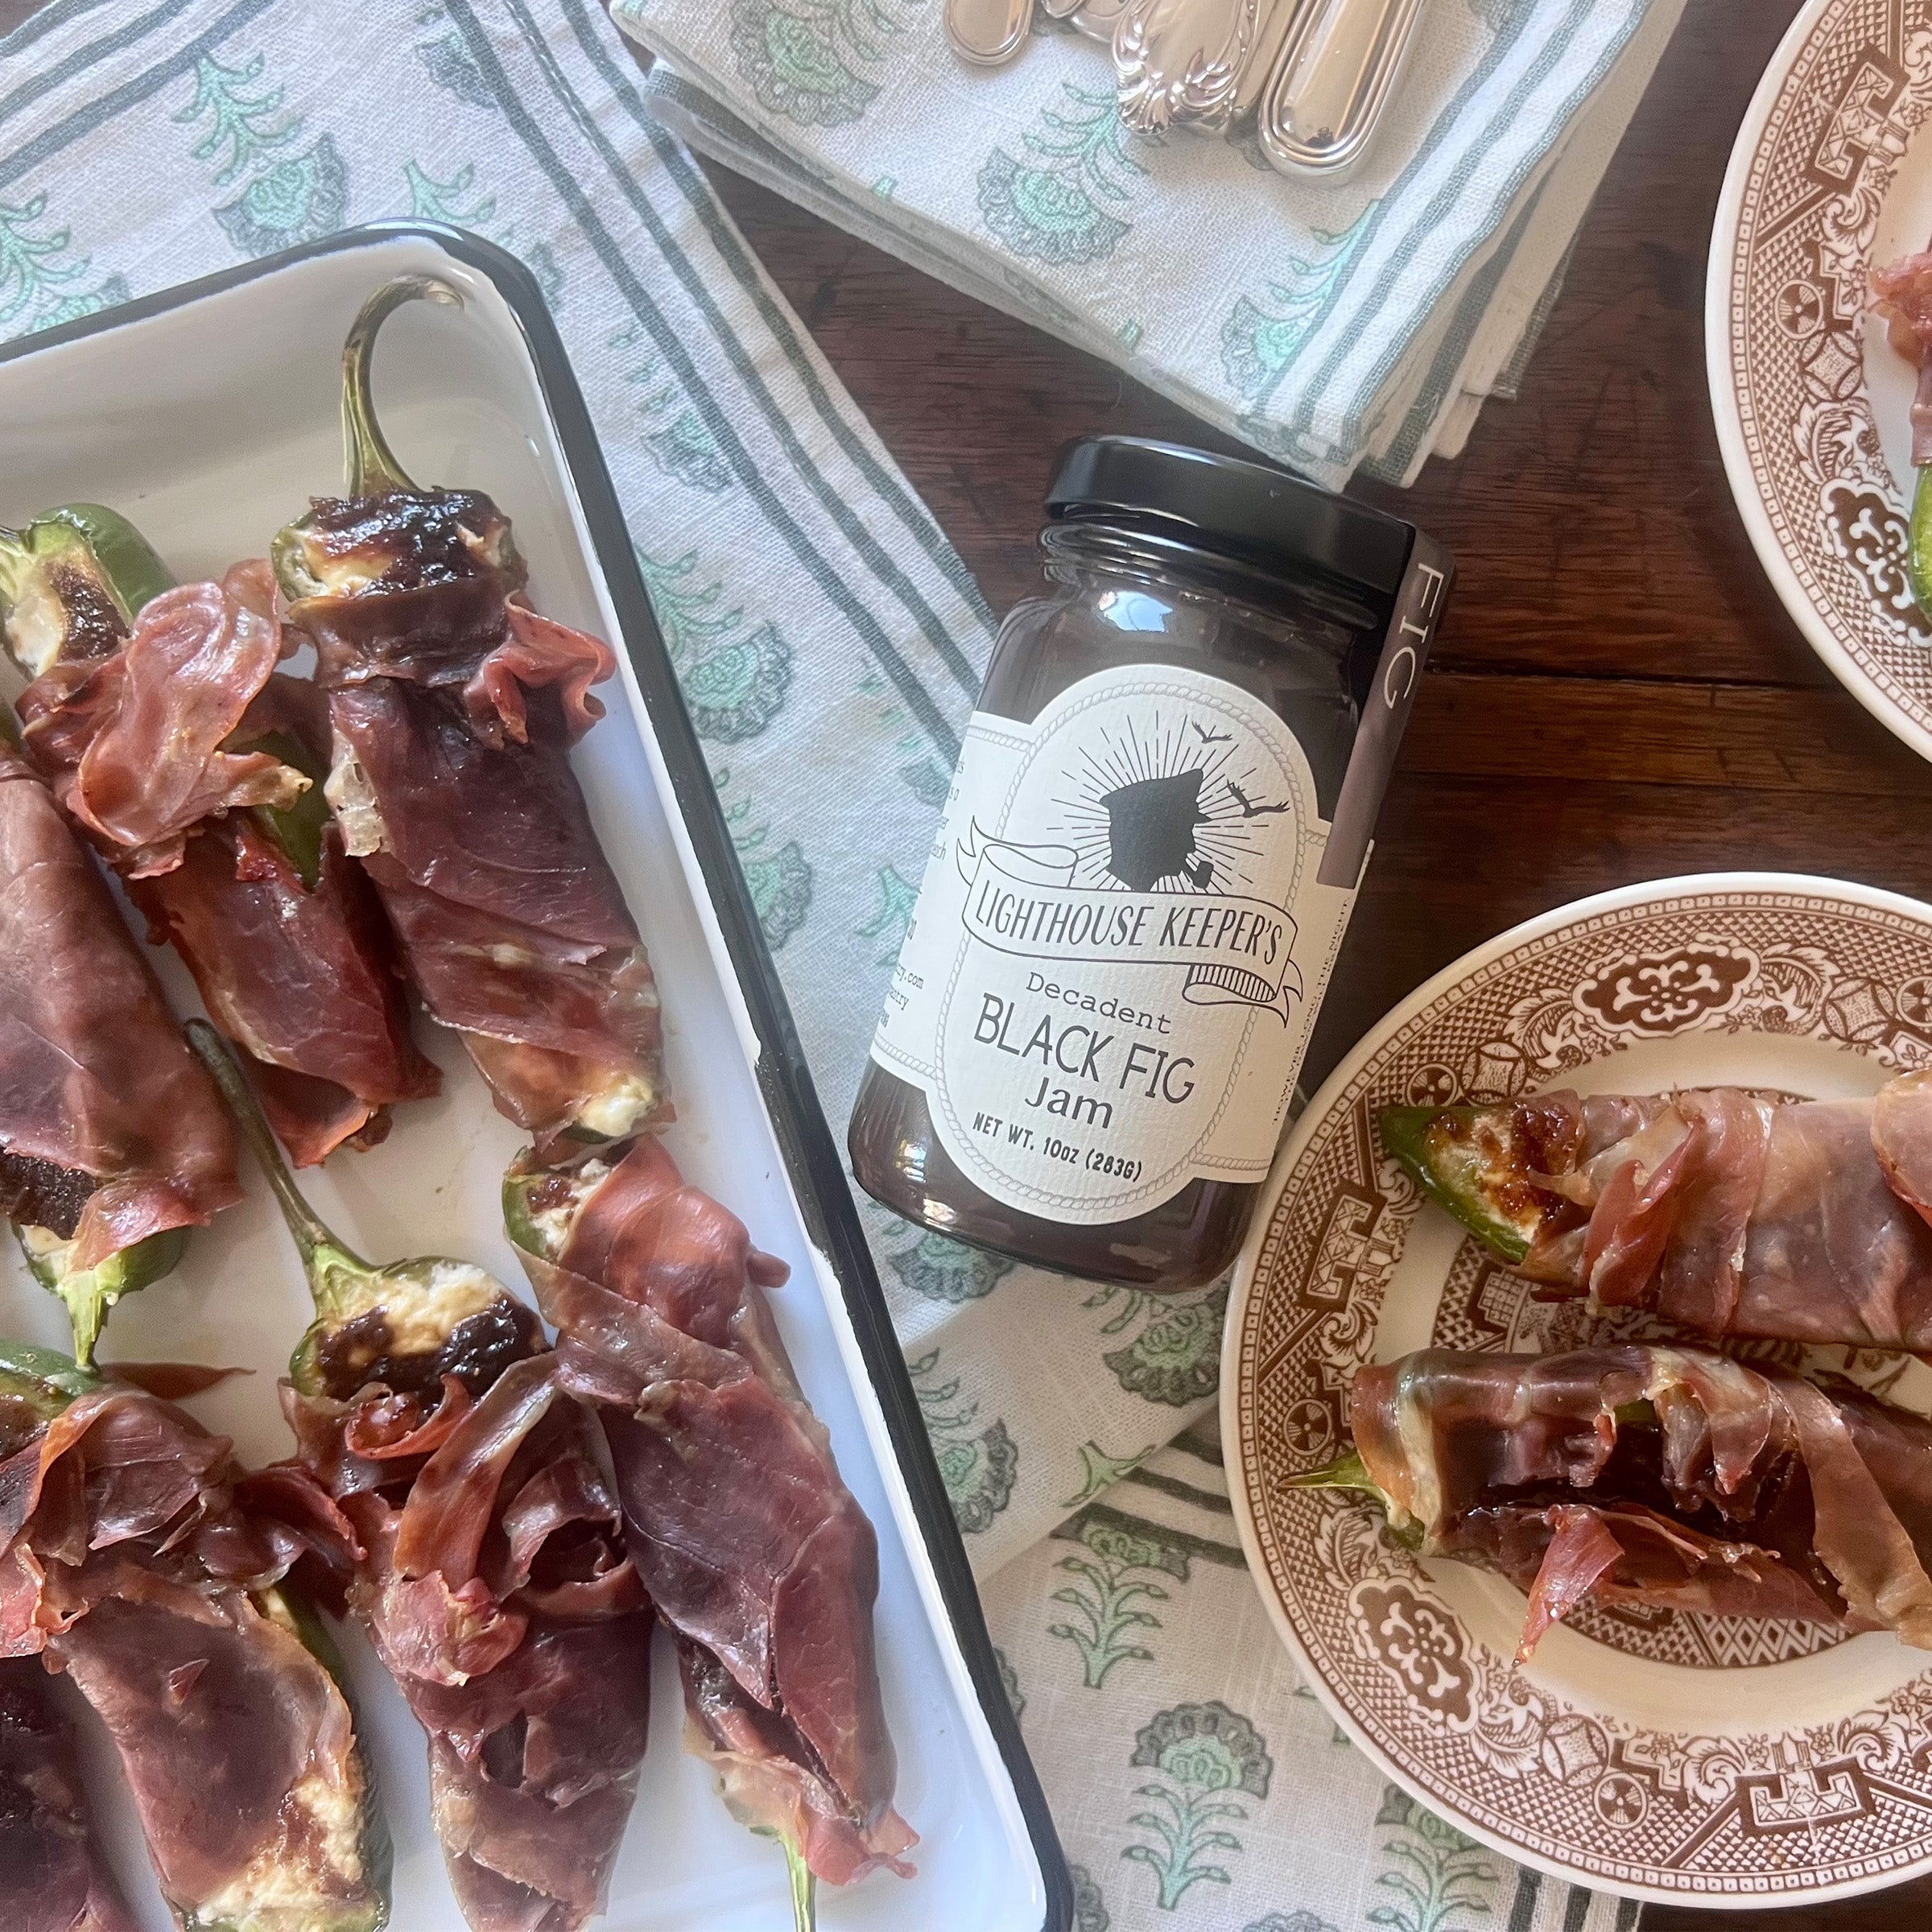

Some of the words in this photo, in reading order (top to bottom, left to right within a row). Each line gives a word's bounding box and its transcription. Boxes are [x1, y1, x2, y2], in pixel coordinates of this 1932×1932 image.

[1384, 563, 1444, 709] FIG
[976, 880, 1154, 947] LIGHTHOUSE
[1159, 906, 1282, 965] KEEPER'S
[1026, 971, 1171, 1034] Decadent
[973, 992, 1116, 1084] BLACK
[1118, 1042, 1195, 1104] FIG
[1024, 1076, 1113, 1129] Jam
[972, 1111, 1003, 1137] NET
[1007, 1123, 1034, 1151] WT.
[1085, 1148, 1142, 1183] (283G)
